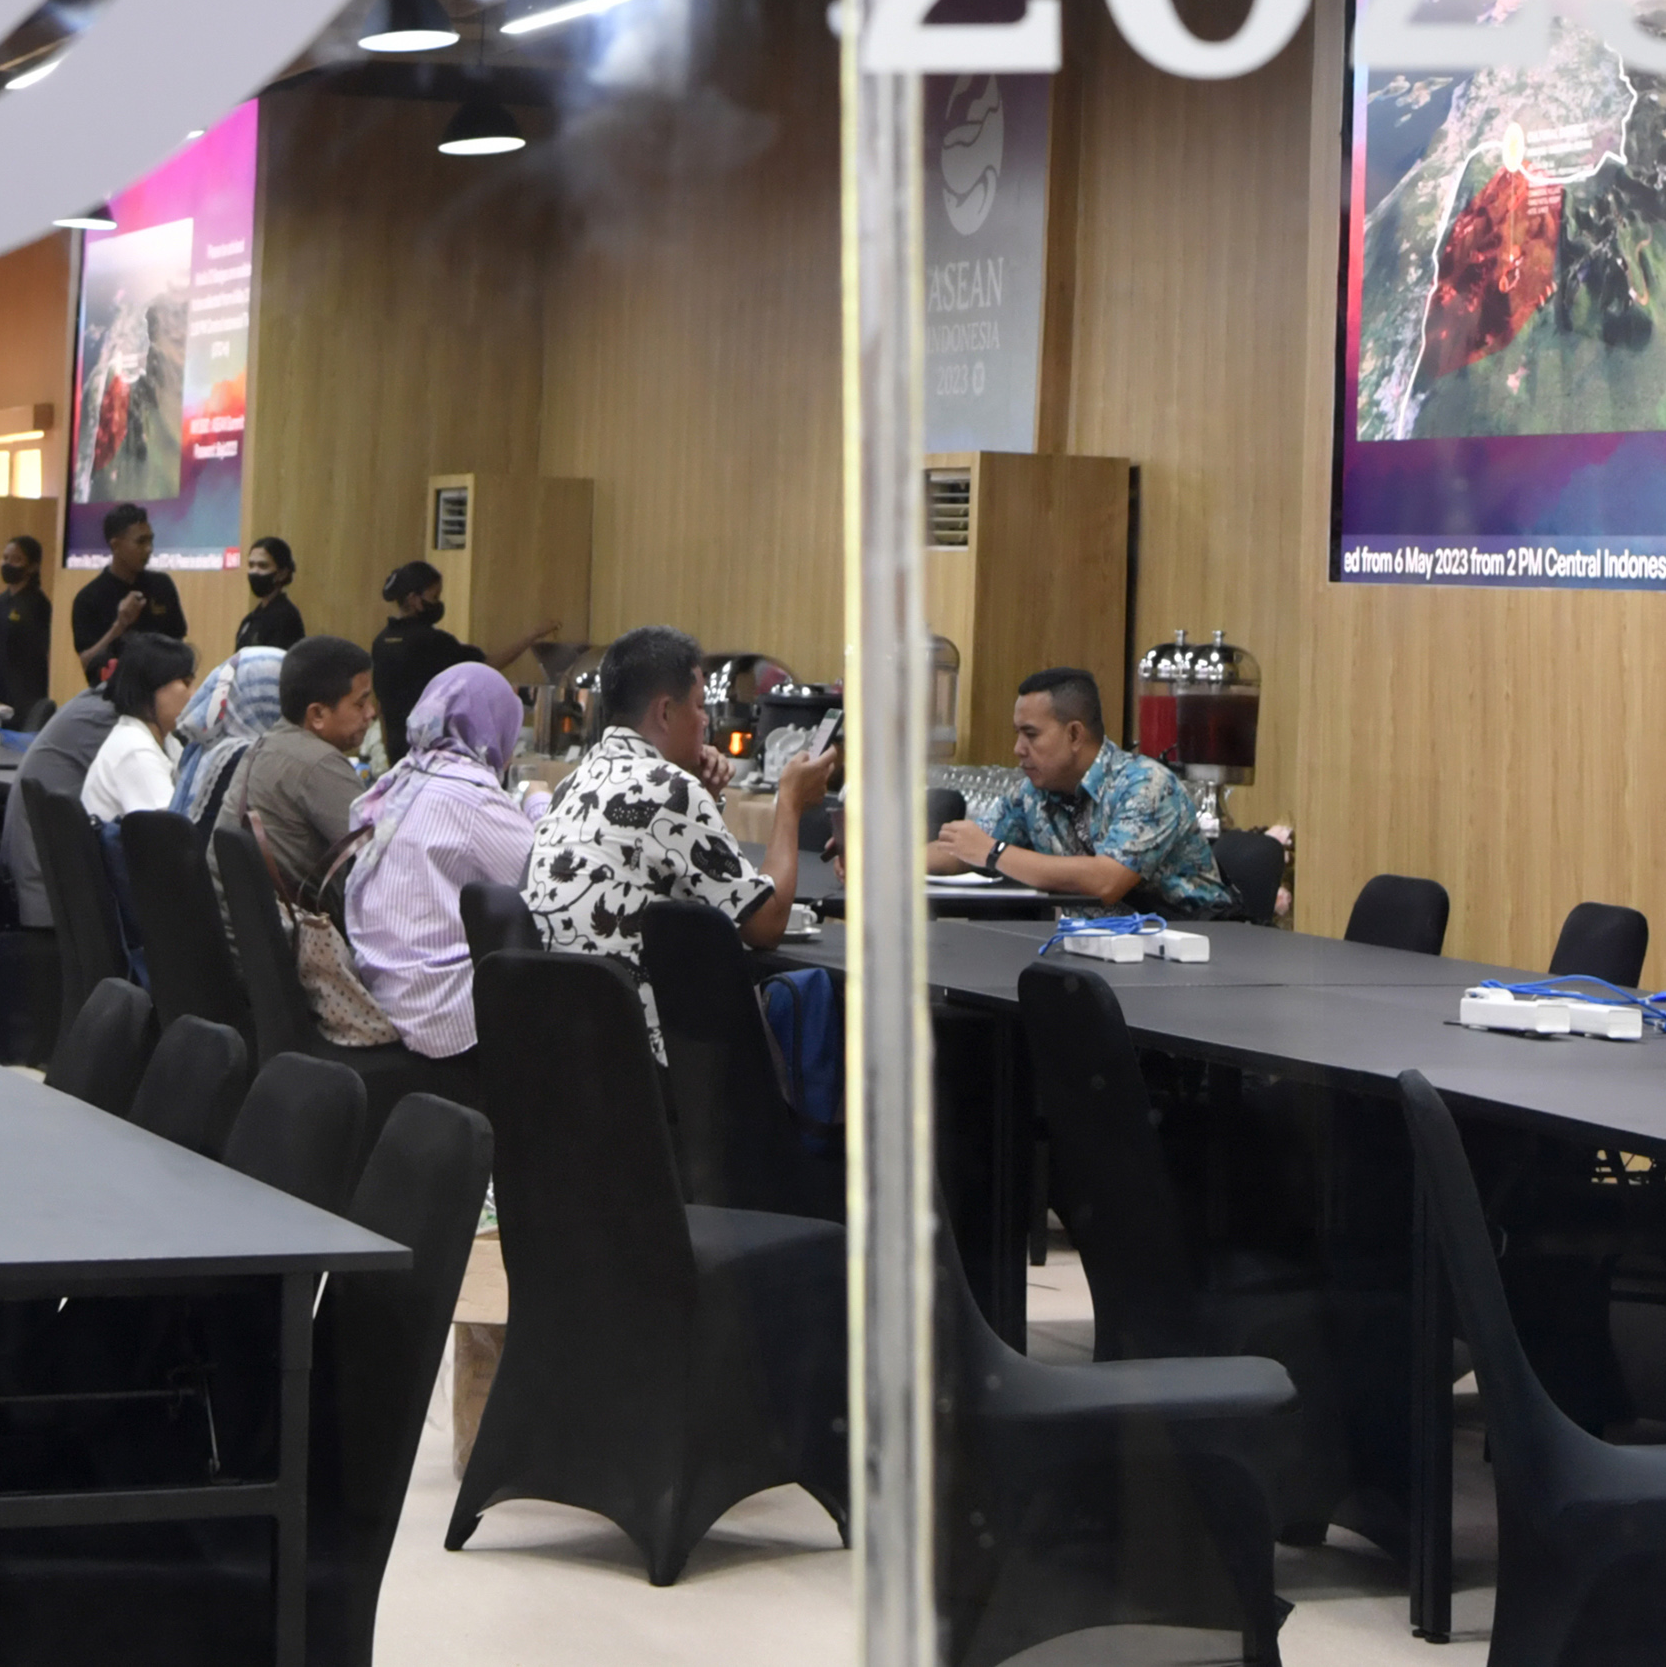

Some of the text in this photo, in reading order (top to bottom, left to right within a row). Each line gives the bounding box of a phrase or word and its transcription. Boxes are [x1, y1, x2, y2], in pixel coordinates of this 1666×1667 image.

[927, 256, 1004, 312] ASEAN
[1361, 545, 1393, 574] from
[1394, 547, 1403, 574] 6
[1405, 546, 1433, 581] May
[1435, 547, 1469, 576] 2023
[1470, 546, 1504, 577] from
[1506, 548, 1516, 577] 2
[1518, 547, 1543, 577] PM
[1545, 546, 1602, 579] Central
